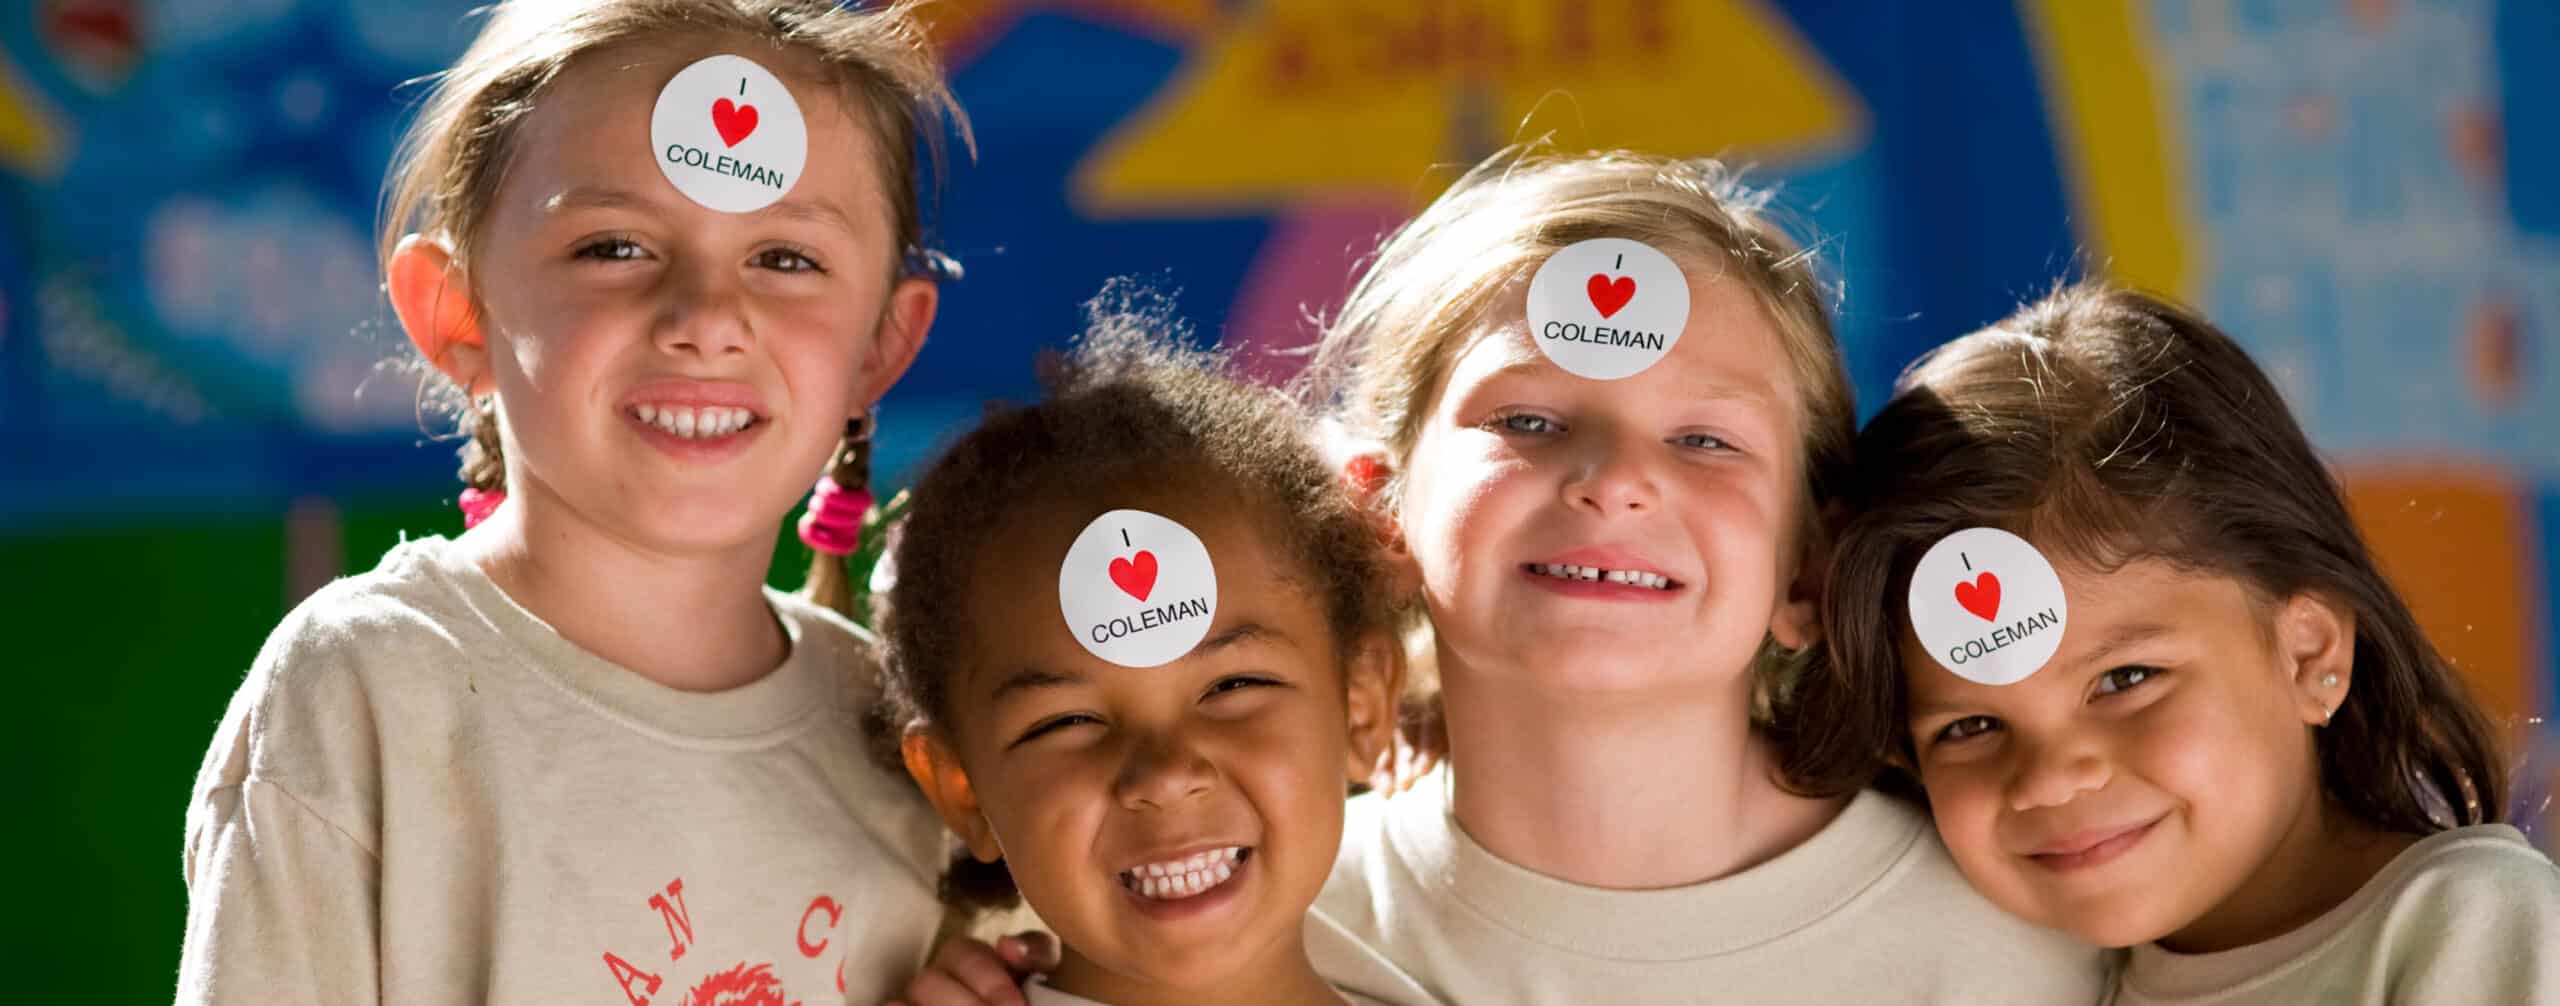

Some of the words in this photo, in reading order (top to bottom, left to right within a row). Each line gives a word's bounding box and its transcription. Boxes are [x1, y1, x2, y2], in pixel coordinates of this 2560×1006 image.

[739, 77, 747, 96] I
[667, 144, 784, 189] COLEMAN
[1615, 253, 1623, 270] I
[1543, 321, 1665, 351] COLEMAN
[1121, 528, 1131, 548] I
[1960, 552, 1972, 571] I
[1090, 597, 1209, 644] COLEMAN
[1950, 608, 2059, 664] COLEMAN
